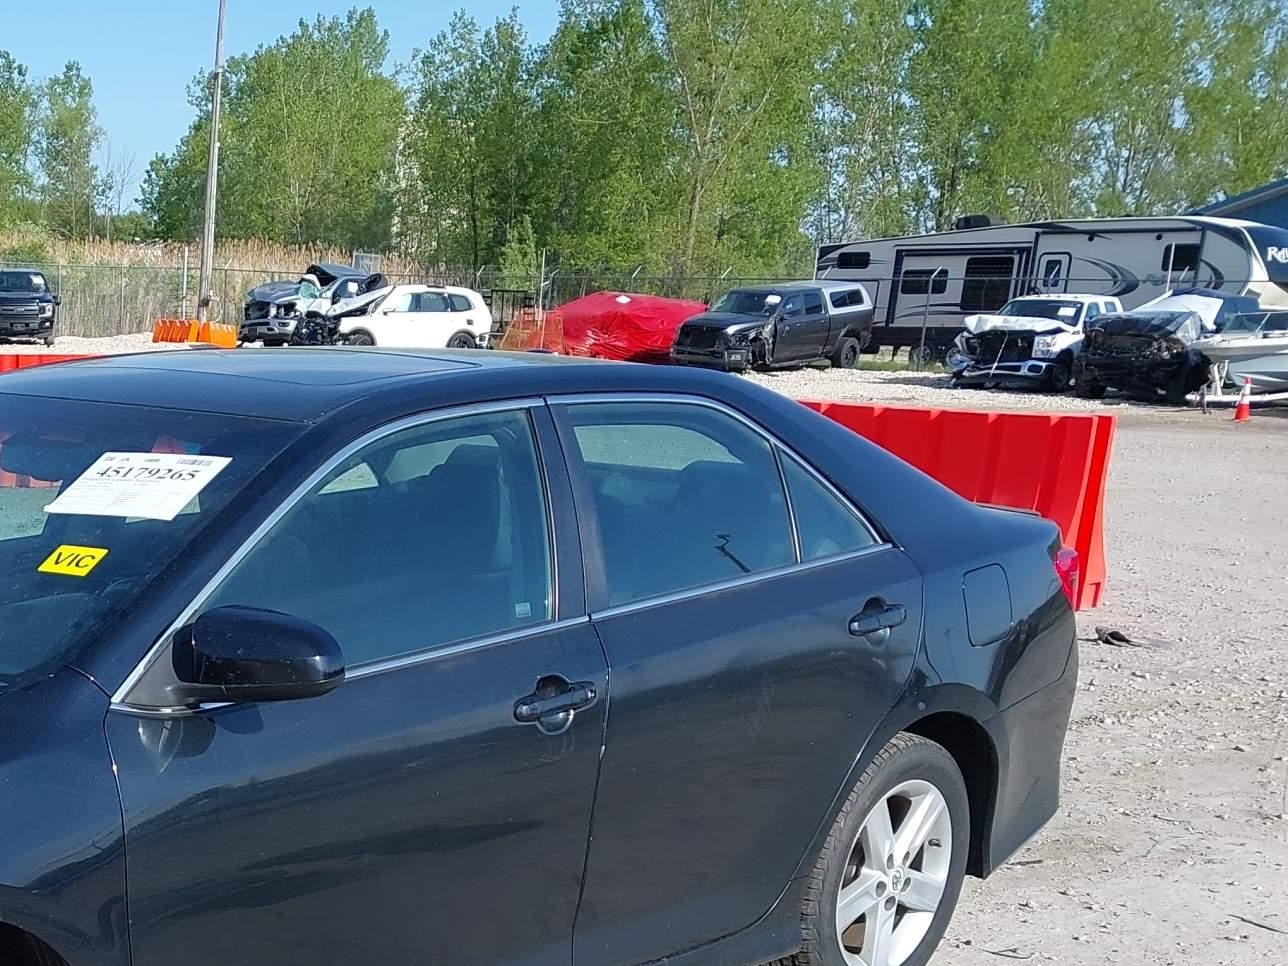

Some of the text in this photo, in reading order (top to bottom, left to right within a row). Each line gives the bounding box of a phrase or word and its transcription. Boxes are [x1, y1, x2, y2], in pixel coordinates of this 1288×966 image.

[1267, 246, 1288, 264] Refl
[96, 466, 202, 481] 45179265
[54, 551, 96, 568] VIC
